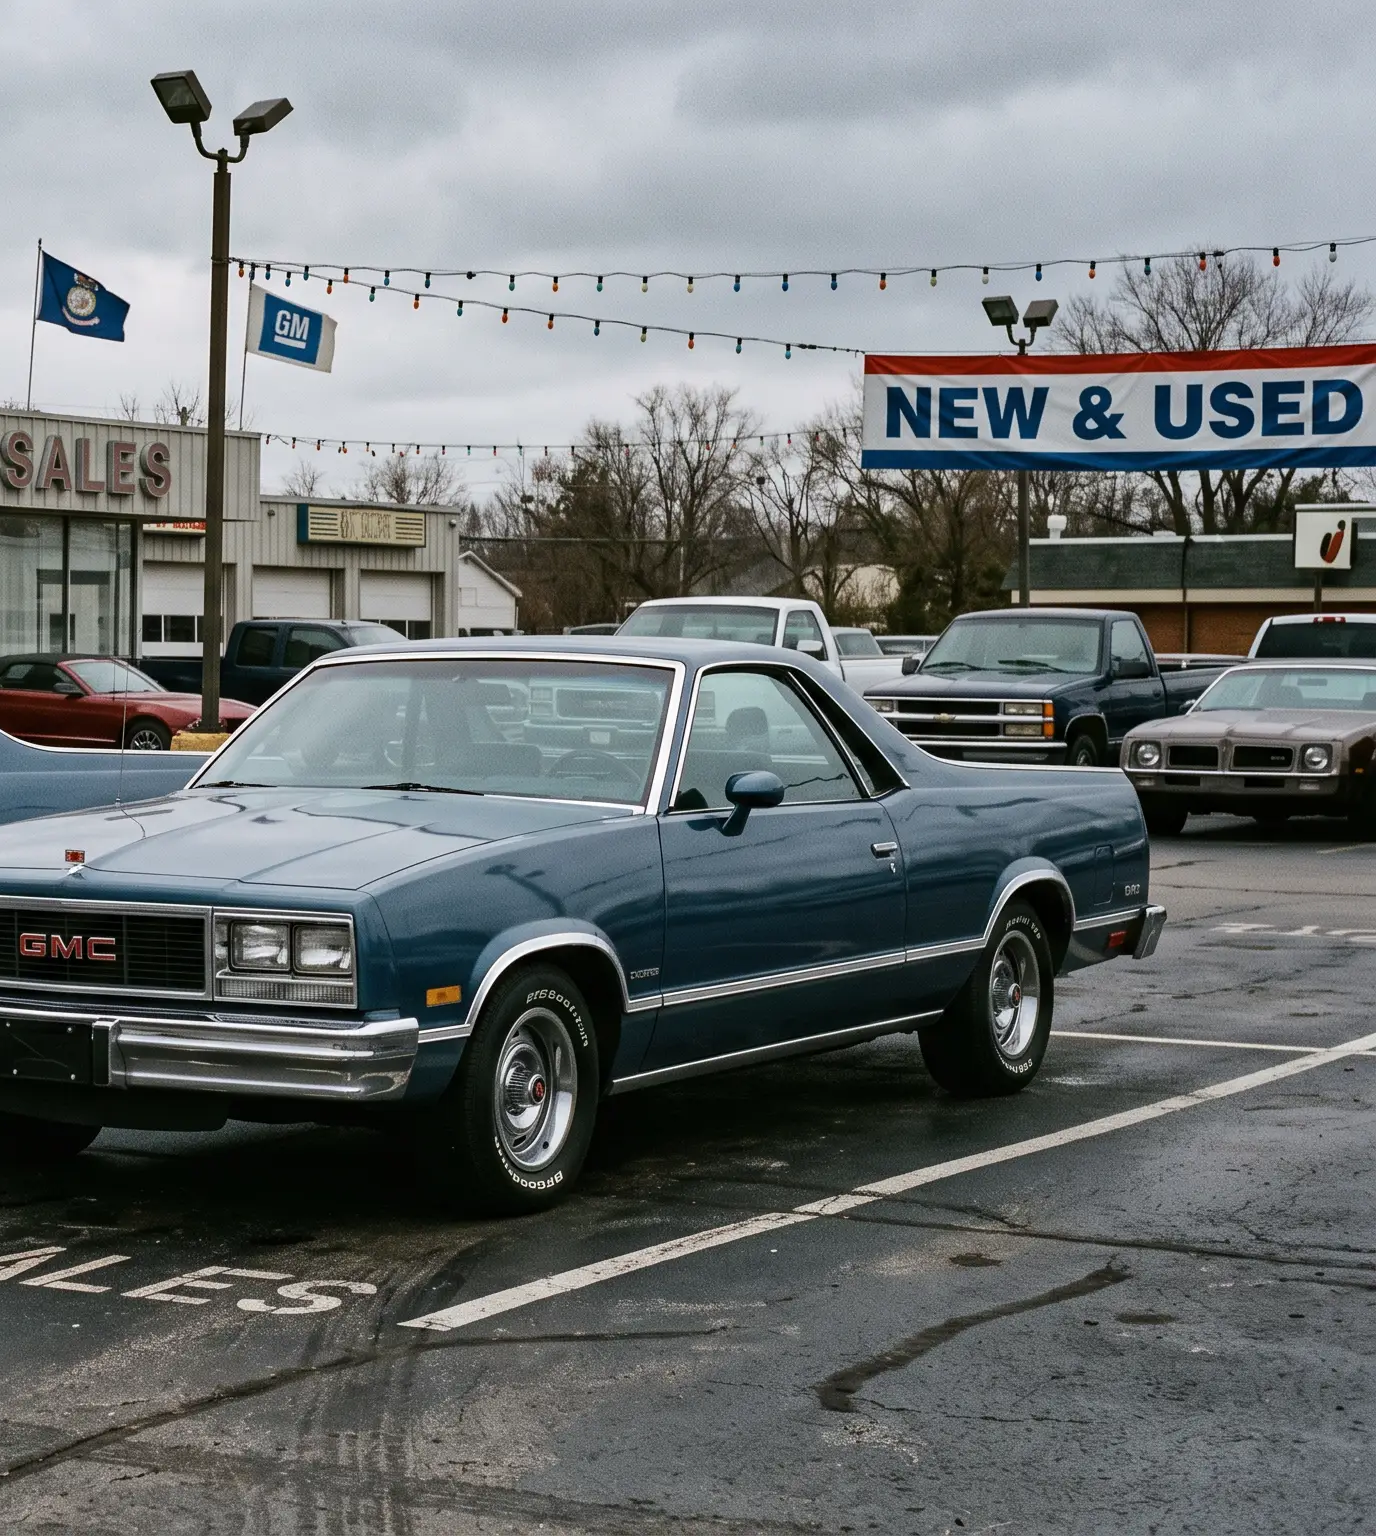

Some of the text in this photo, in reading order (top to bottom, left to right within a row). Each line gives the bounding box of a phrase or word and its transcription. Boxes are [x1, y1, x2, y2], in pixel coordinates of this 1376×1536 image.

[276, 310, 310, 340] GM
[886, 379, 1364, 440] NEW & USED
[0, 431, 172, 498] SALES
[20, 933, 116, 960] GMC
